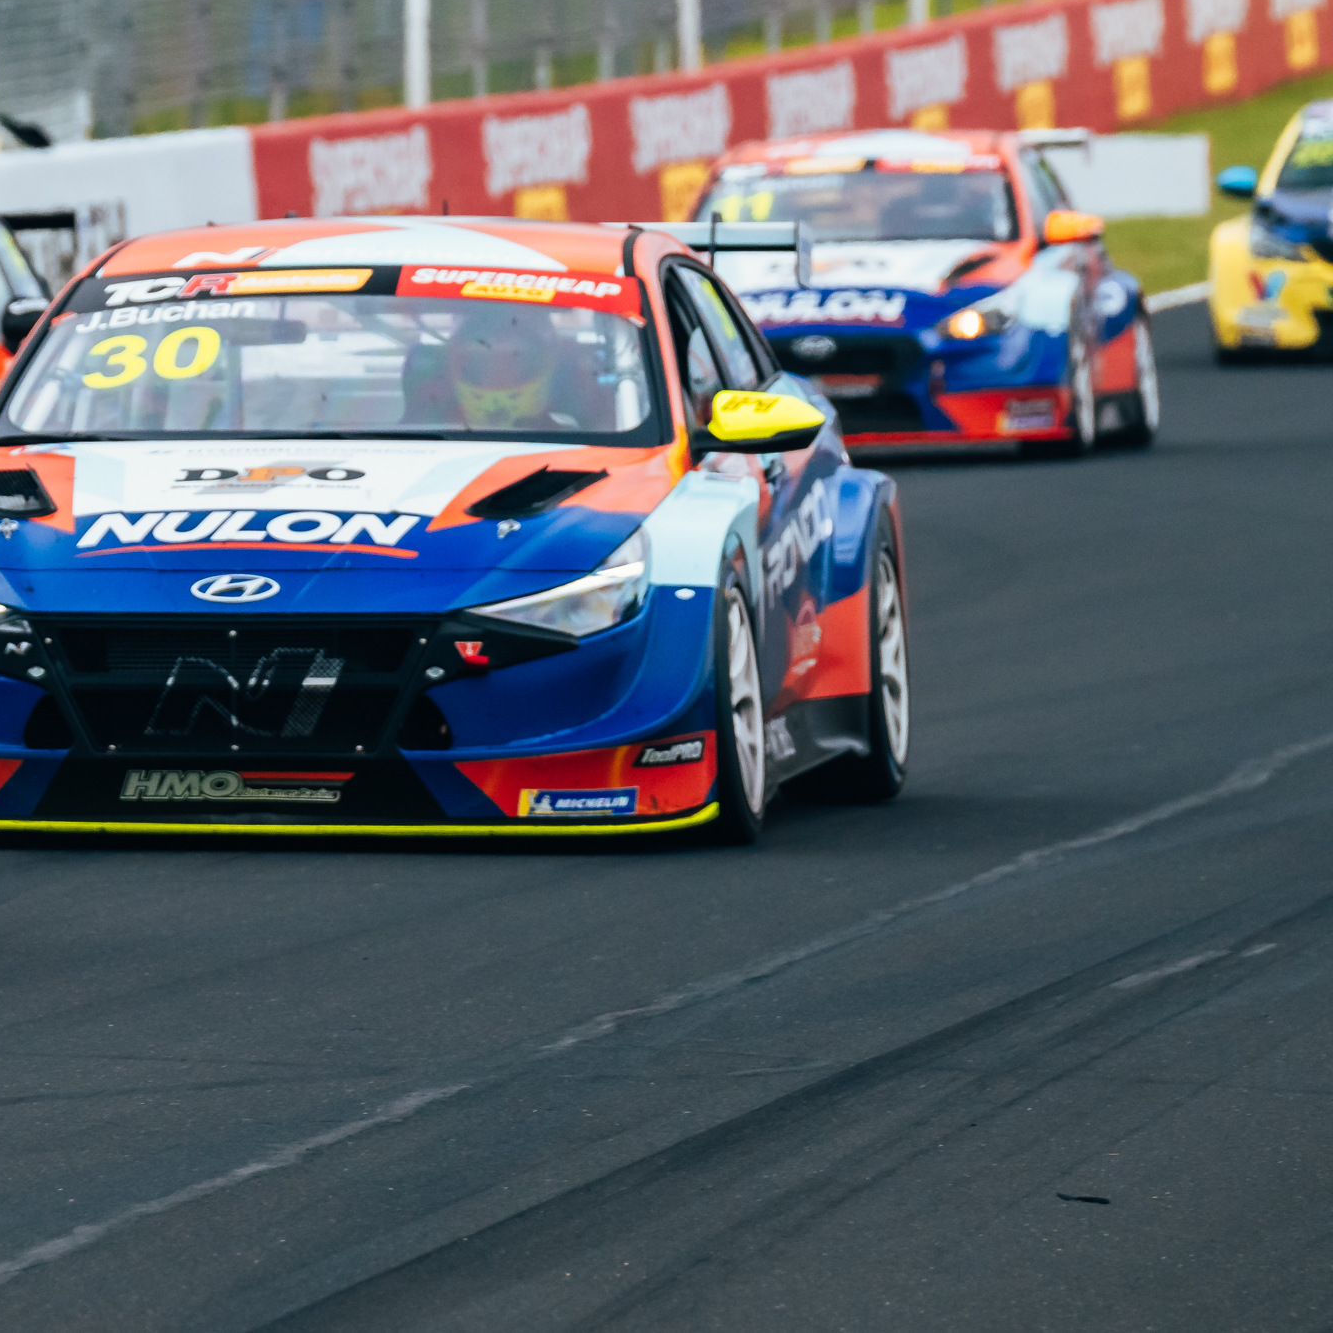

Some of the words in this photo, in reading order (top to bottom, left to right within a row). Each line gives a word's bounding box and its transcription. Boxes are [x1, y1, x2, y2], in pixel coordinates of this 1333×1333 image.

[103, 272, 238, 307] TCR
[234, 272, 360, 291] Australia
[411, 267, 623, 298] SUPERCHEAP
[473, 284, 547, 298] AUTO
[81, 326, 222, 390] 30
[173, 467, 366, 482] DPO
[77, 511, 421, 549] NULON
[121, 770, 243, 798] HMO
[554, 795, 630, 809] MICHELIN
